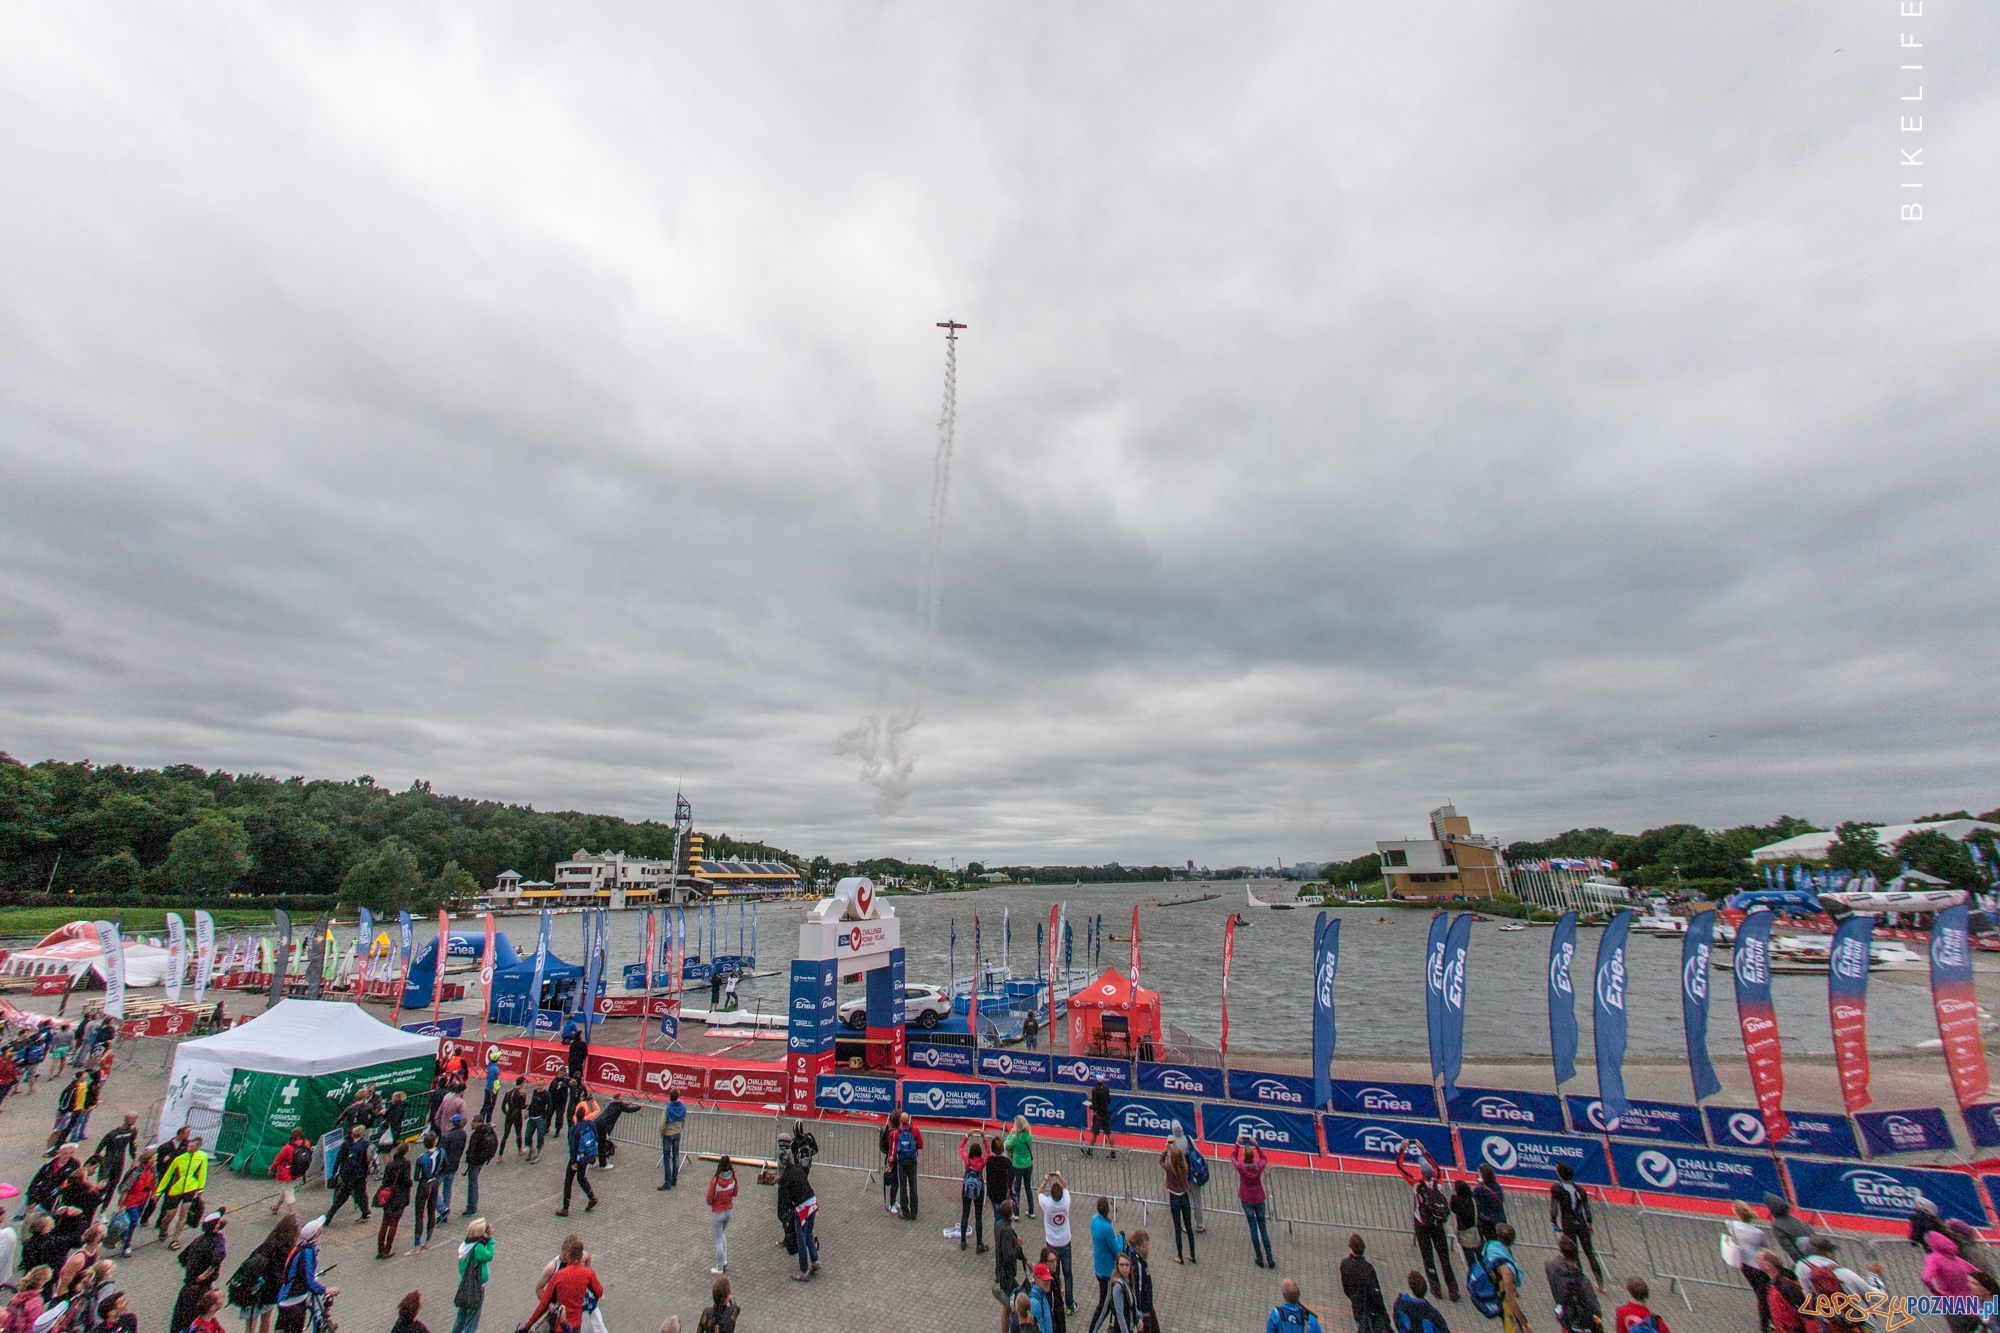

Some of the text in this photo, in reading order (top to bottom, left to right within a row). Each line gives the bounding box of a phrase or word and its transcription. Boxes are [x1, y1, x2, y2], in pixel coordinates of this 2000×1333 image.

[862, 928, 882, 936] CHALLENGE
[448, 943, 474, 955] Enea
[1742, 937, 1756, 984] Enea
[1755, 941, 1765, 984] TRITOUR
[1838, 937, 1855, 977] Enea
[1432, 942, 1445, 990] Enea
[1557, 942, 1574, 993] Enea
[1691, 944, 1710, 998] Enea
[1321, 951, 1335, 1008] Enea
[1449, 948, 1466, 1008] Enea
[1606, 947, 1624, 1010] Enea
[796, 1002, 815, 1010] Enea
[822, 1000, 835, 1009] Enea
[536, 1019, 552, 1027] Enea
[1746, 1020, 1774, 1033] Enea
[940, 1051, 965, 1059] CHALLENGE
[1013, 1059, 1041, 1067] CHALLENGE
[1090, 1065, 1120, 1073] CHALLENGE
[601, 1069, 625, 1083] Enea
[673, 1073, 697, 1081] CHALLENGE
[747, 1078, 777, 1086] CHALLENGE
[855, 1085, 886, 1094] CHALLENGE
[1164, 1077, 1203, 1092] Enea
[946, 1091, 980, 1099] CHALLENGE
[1258, 1087, 1302, 1103] Enea
[1364, 1096, 1412, 1111] Enea
[269, 1113, 301, 1121] PIERWSZEJ
[1024, 1105, 1065, 1120] Enea
[1482, 1105, 1534, 1122] Enea
[1624, 1108, 1680, 1121] HALLENGE
[271, 1120, 297, 1128] POMOCY
[1125, 1113, 1171, 1129] Enea
[1620, 1116, 1649, 1125] FAMILY
[1238, 1123, 1289, 1143] Enea
[1517, 1142, 1584, 1158] CHALLENGE
[1518, 1152, 1549, 1164] FAMILY
[1677, 1158, 1754, 1177] CHALLENGE
[1677, 1168, 1714, 1181] FAMILY
[1853, 1178, 1923, 1198] Enea
[1855, 1194, 1918, 1209] TRITOU
